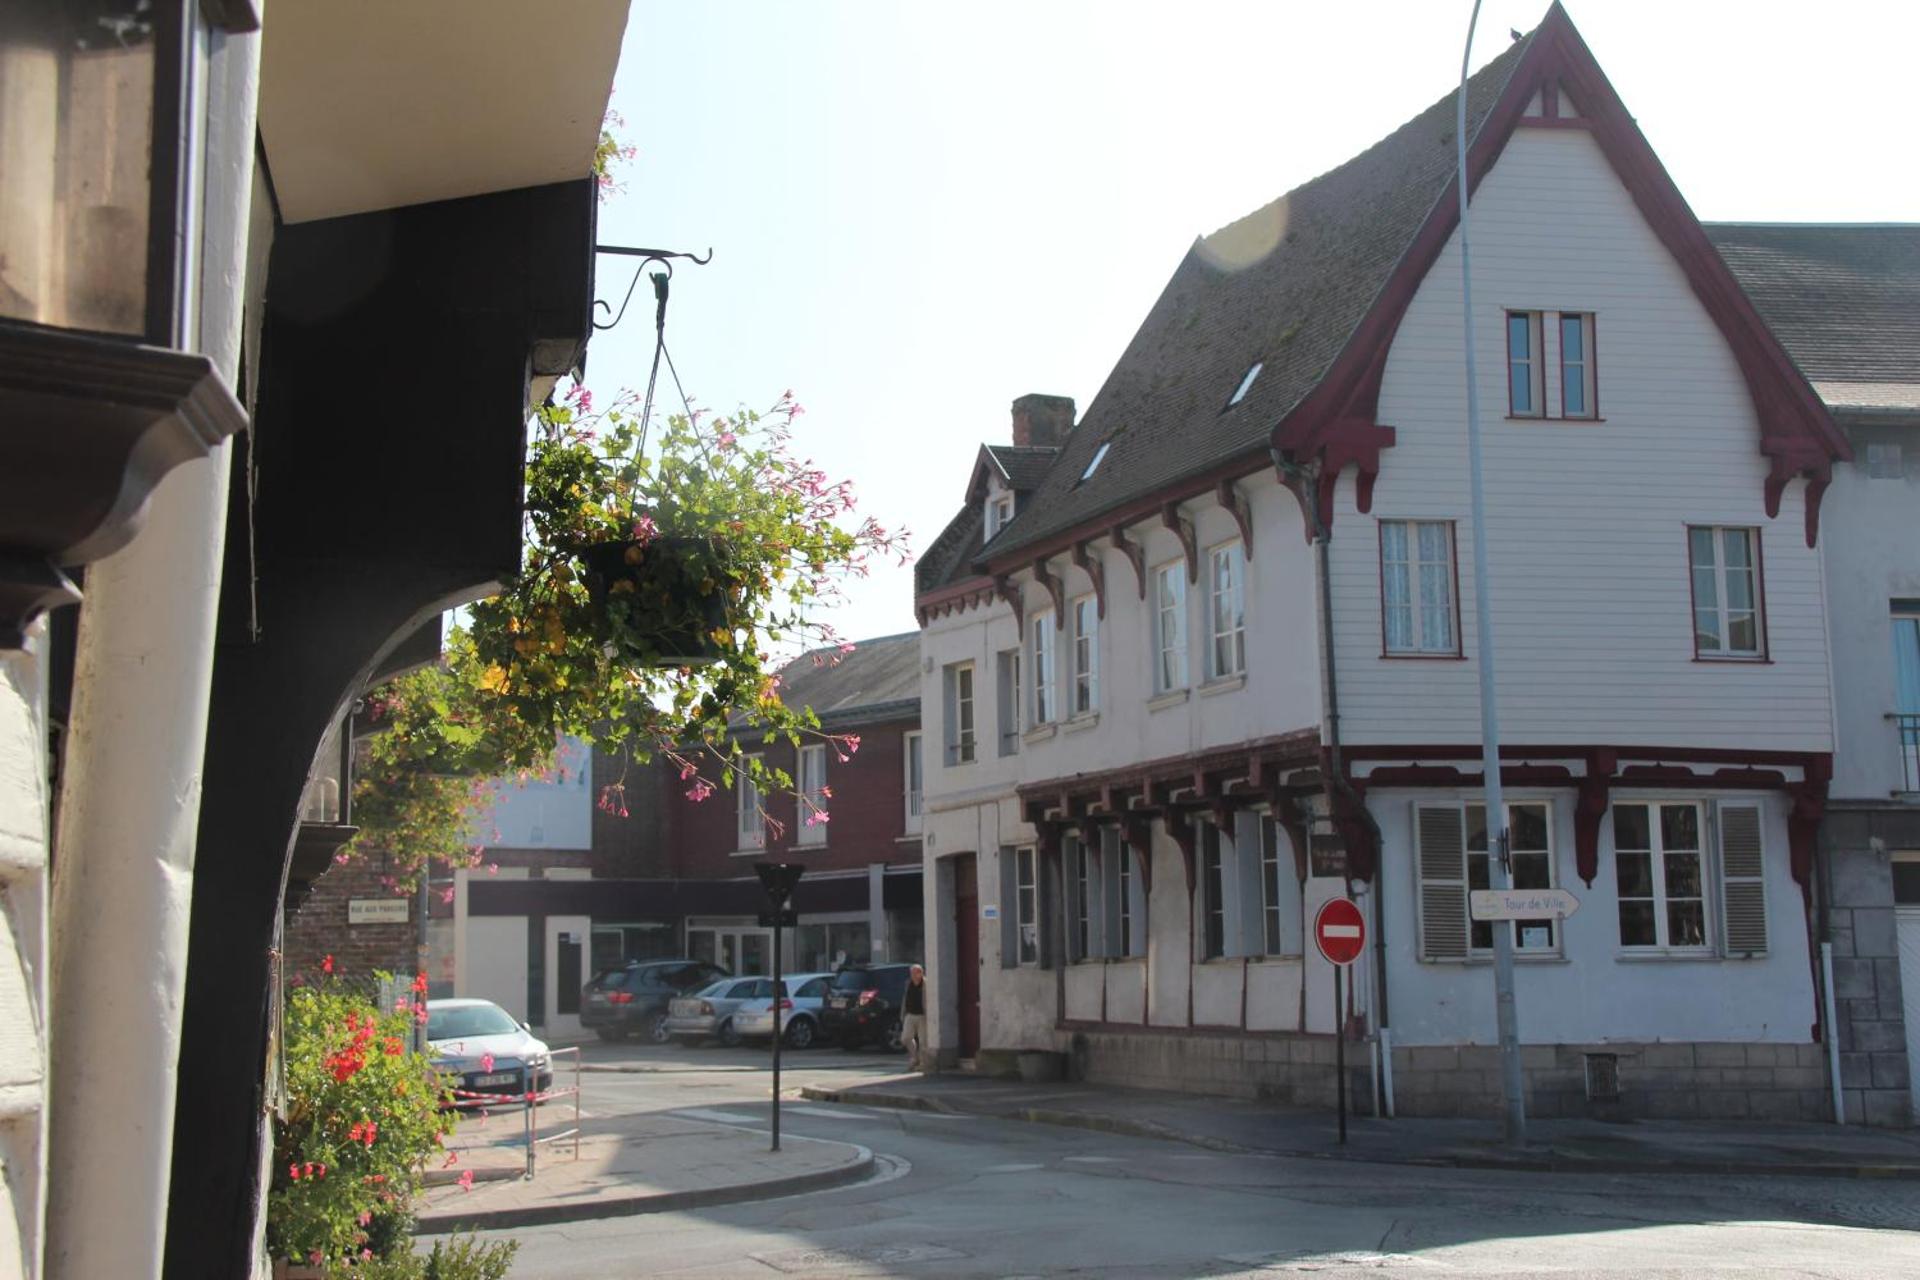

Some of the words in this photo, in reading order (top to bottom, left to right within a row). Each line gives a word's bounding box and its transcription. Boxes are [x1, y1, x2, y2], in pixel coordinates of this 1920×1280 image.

[1504, 897, 1527, 910] Tour
[1528, 896, 1541, 910] de
[1542, 897, 1566, 909] Ville
